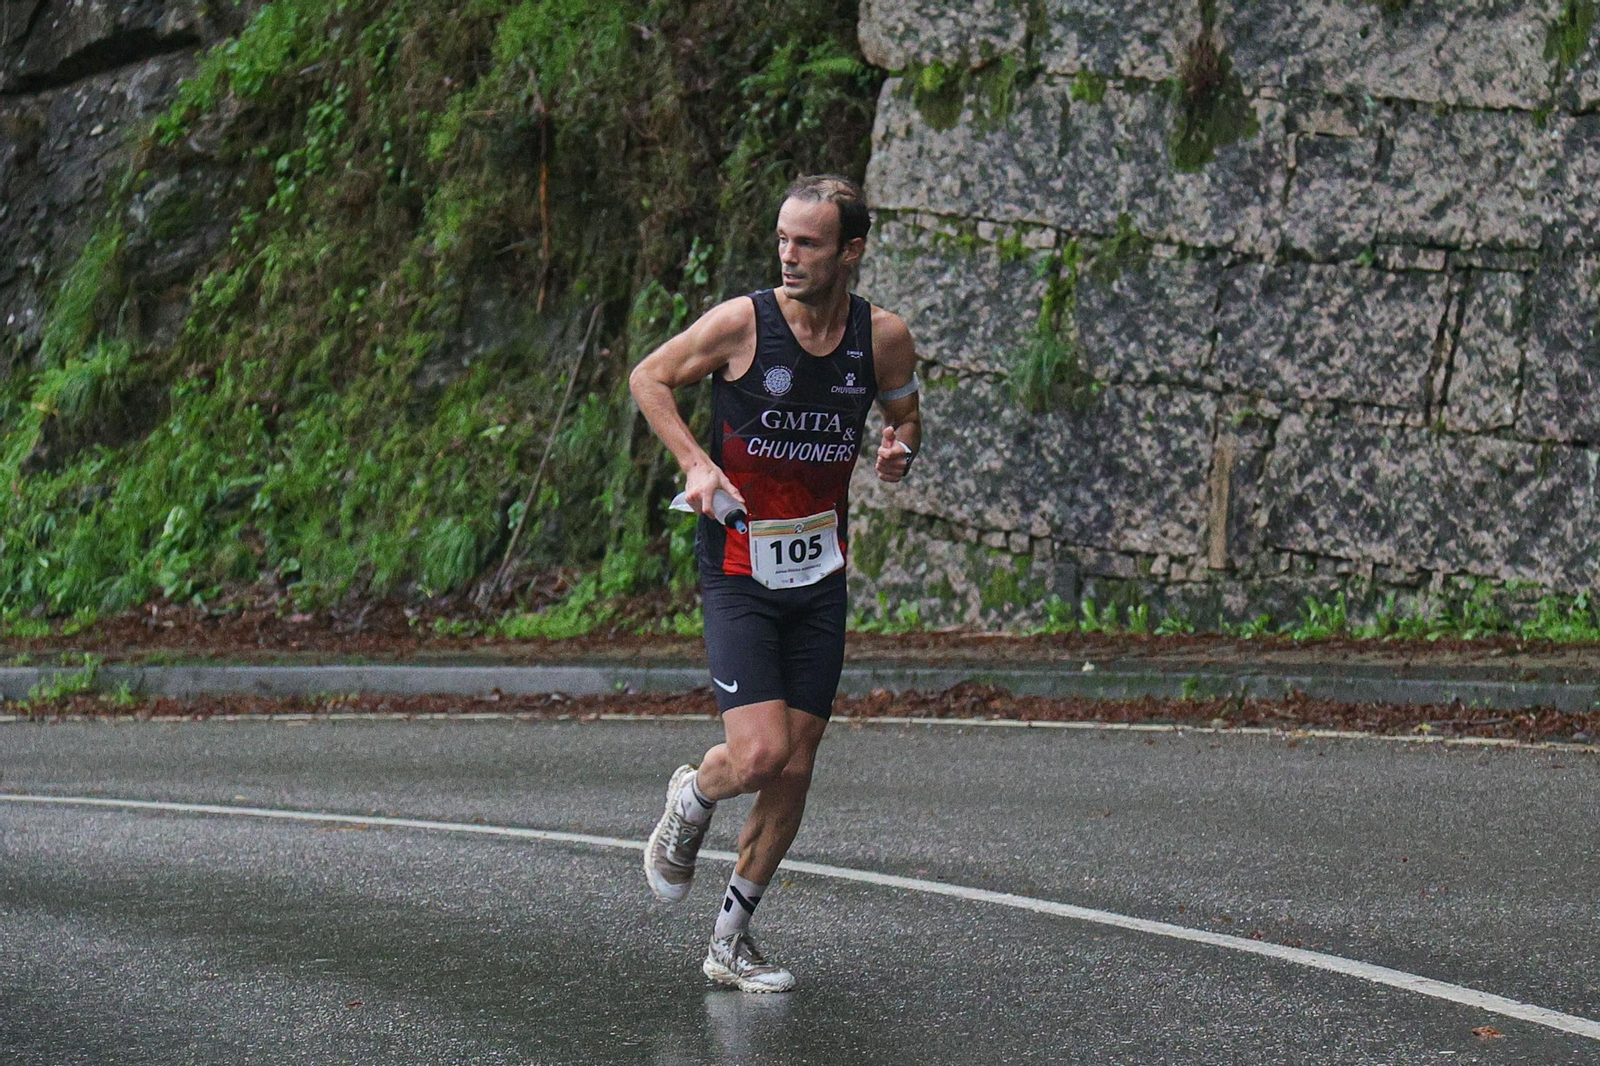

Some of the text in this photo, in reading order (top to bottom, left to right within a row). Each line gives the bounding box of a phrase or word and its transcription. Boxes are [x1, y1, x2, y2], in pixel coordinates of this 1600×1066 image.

[831, 385, 867, 394] CHUVONERS
[761, 410, 856, 441] GMTA &
[747, 437, 855, 463] CHUVONERS
[769, 534, 823, 565] 105
